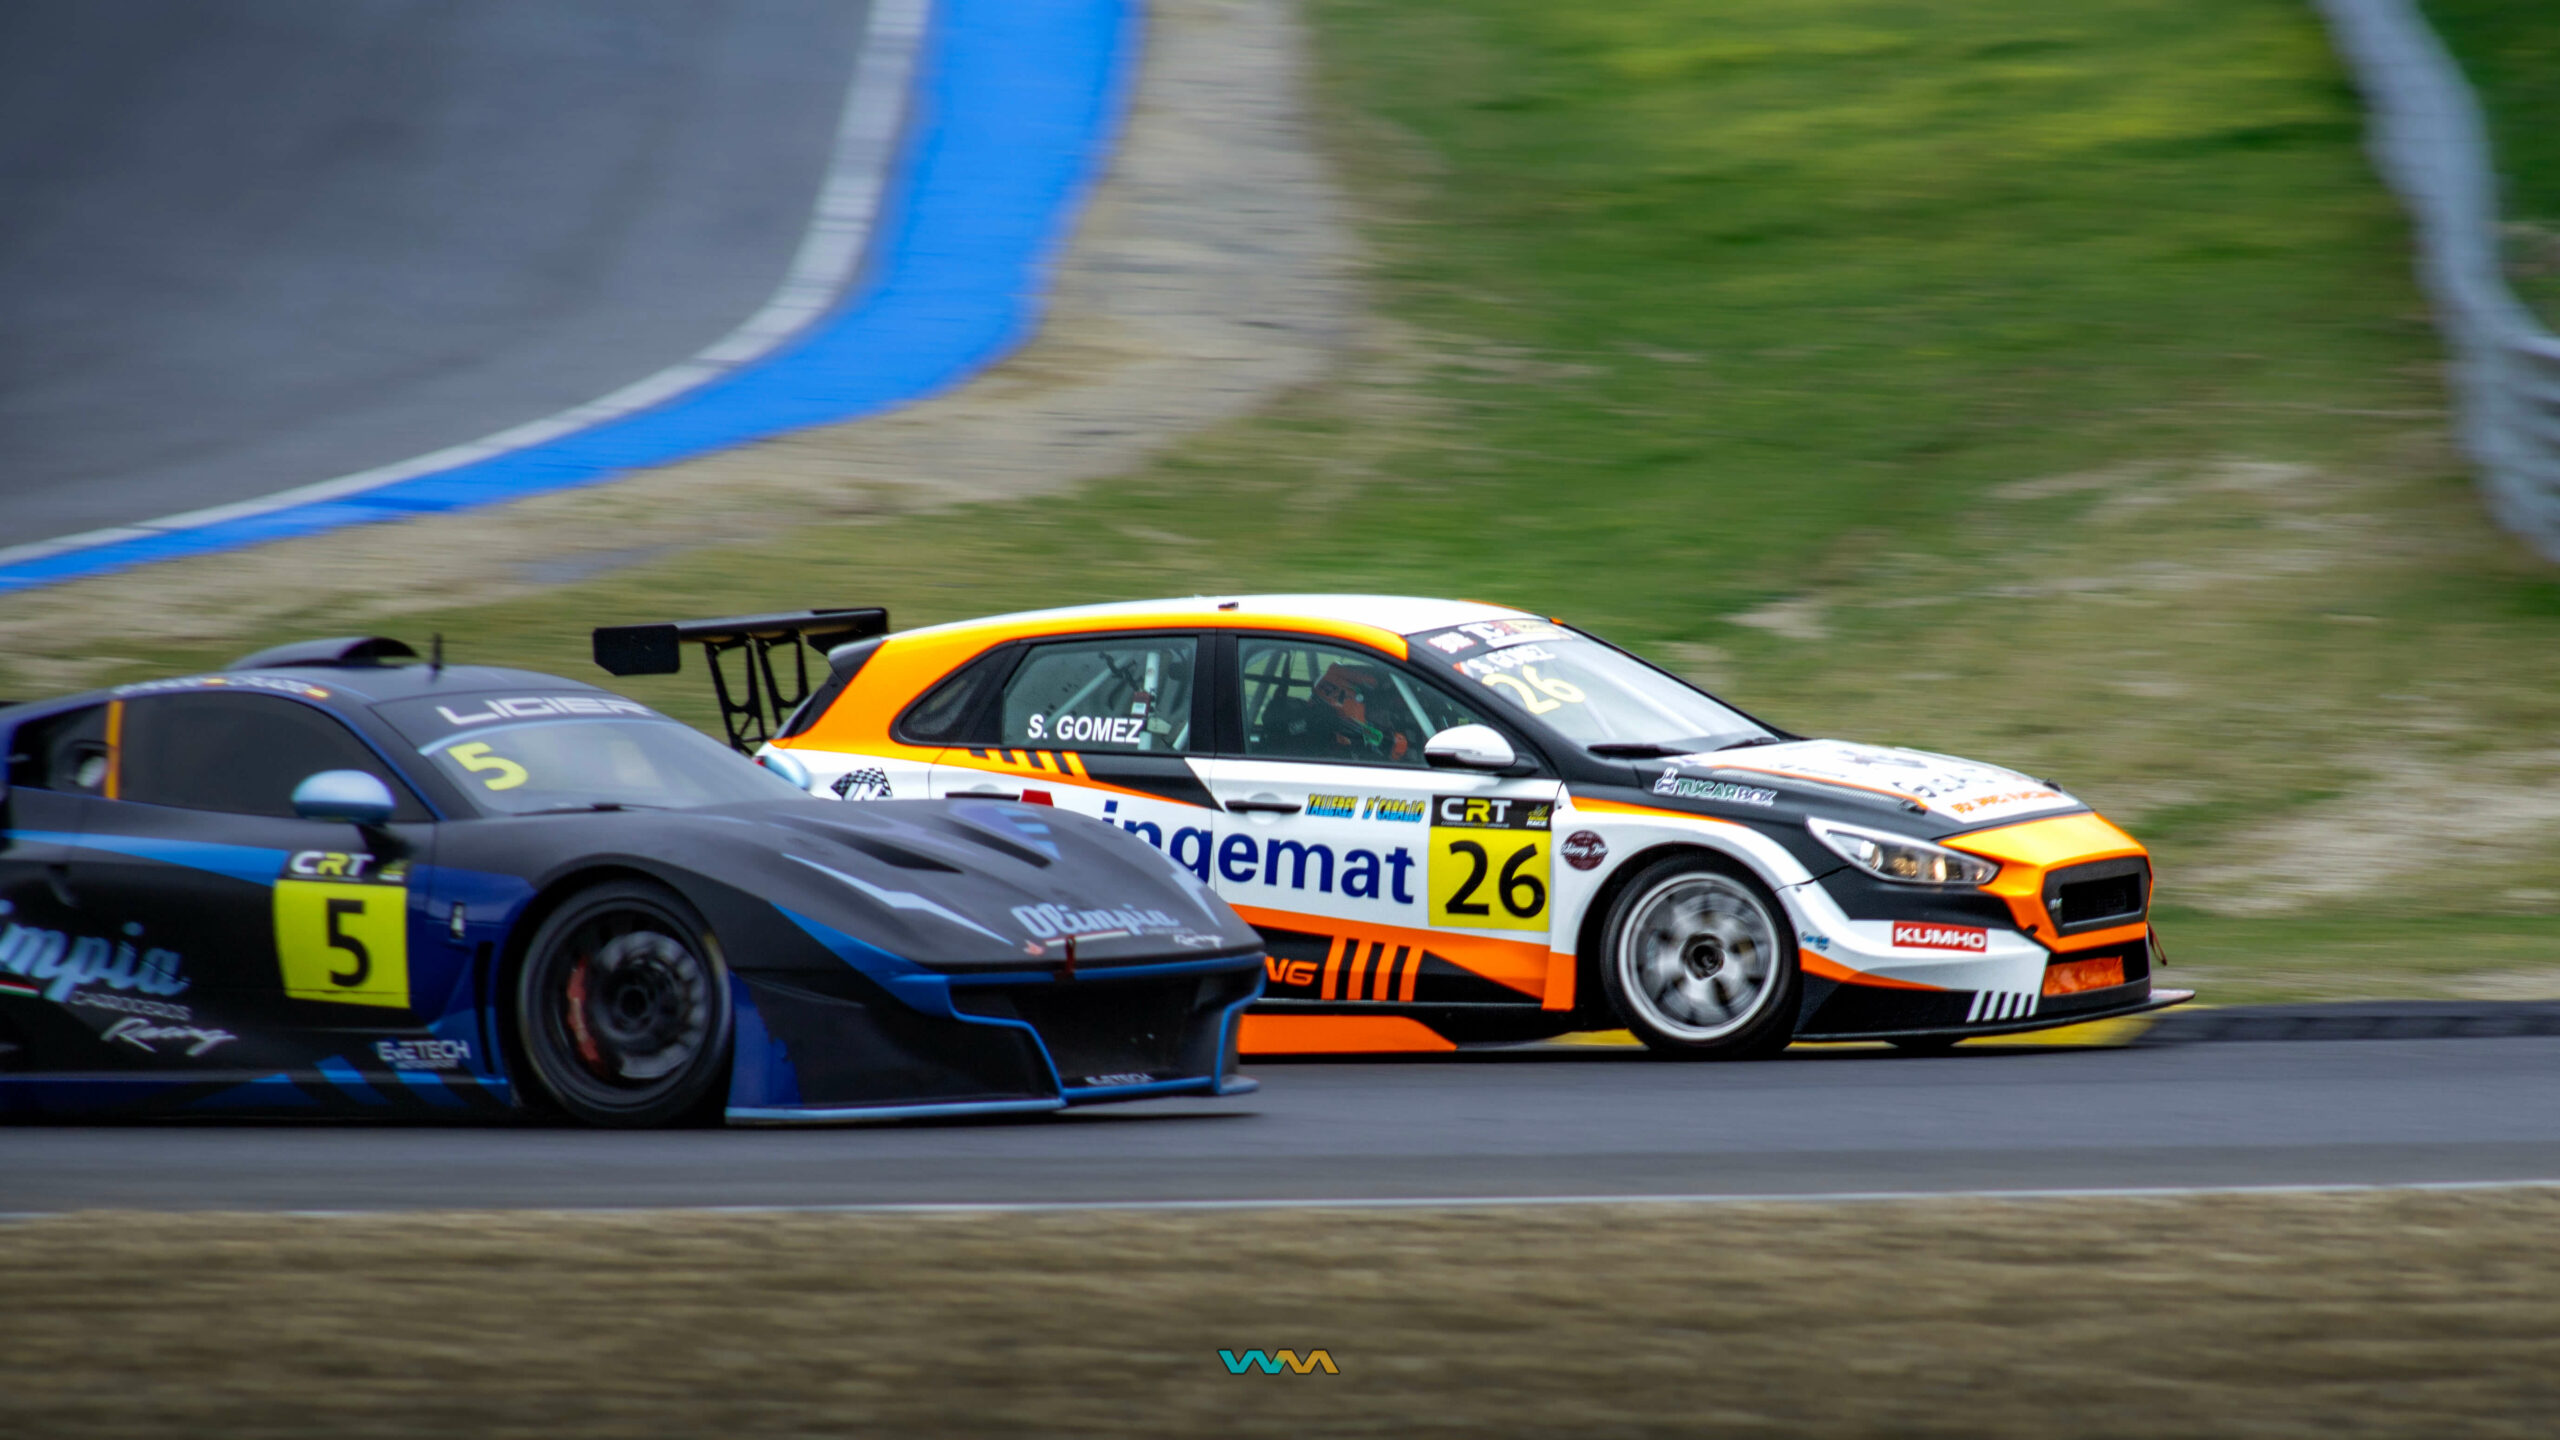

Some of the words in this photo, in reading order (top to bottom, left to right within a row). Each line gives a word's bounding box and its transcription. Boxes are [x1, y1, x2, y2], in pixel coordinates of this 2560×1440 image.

[1482, 664, 1586, 715] 26
[435, 697, 654, 725] LIGIER
[1027, 713, 1048, 739] S.
[1056, 715, 1144, 743] GOMEZ
[447, 742, 529, 791] 5
[1305, 793, 1359, 819] TALLERES
[1675, 777, 1778, 807] TUCARBOX
[1440, 797, 1512, 824] CRT
[290, 851, 375, 877] CRT
[1445, 840, 1546, 919] 26
[1011, 902, 1179, 938] Olimpia
[326, 898, 372, 988] 5
[1895, 926, 1986, 949] KUMHO
